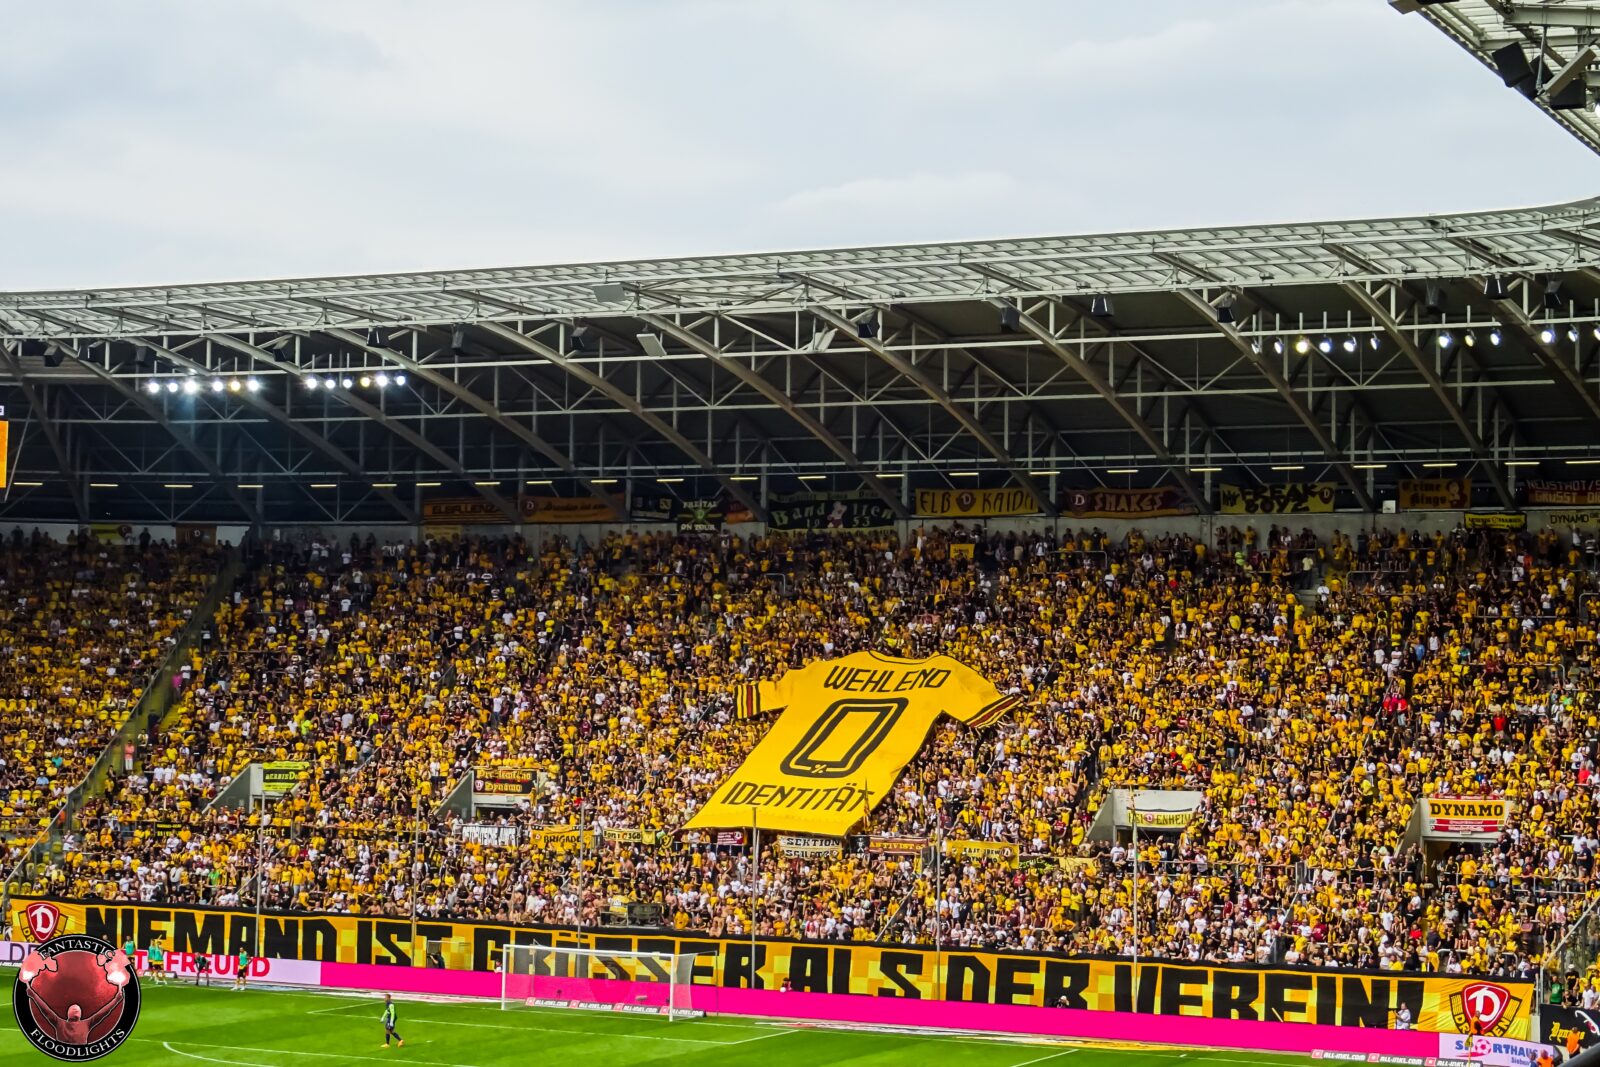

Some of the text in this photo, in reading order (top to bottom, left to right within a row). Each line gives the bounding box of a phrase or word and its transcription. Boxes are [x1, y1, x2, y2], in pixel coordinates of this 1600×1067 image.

[1550, 514, 1590, 524] DYNAMO
[720, 781, 875, 812] IDENTITÄT
[1430, 803, 1504, 817] DYNAMO
[786, 837, 840, 847] SEKTION
[86, 908, 337, 961] NIEMAND
[357, 920, 452, 967] IST
[789, 945, 923, 999] ALS
[946, 955, 1090, 1010] DER
